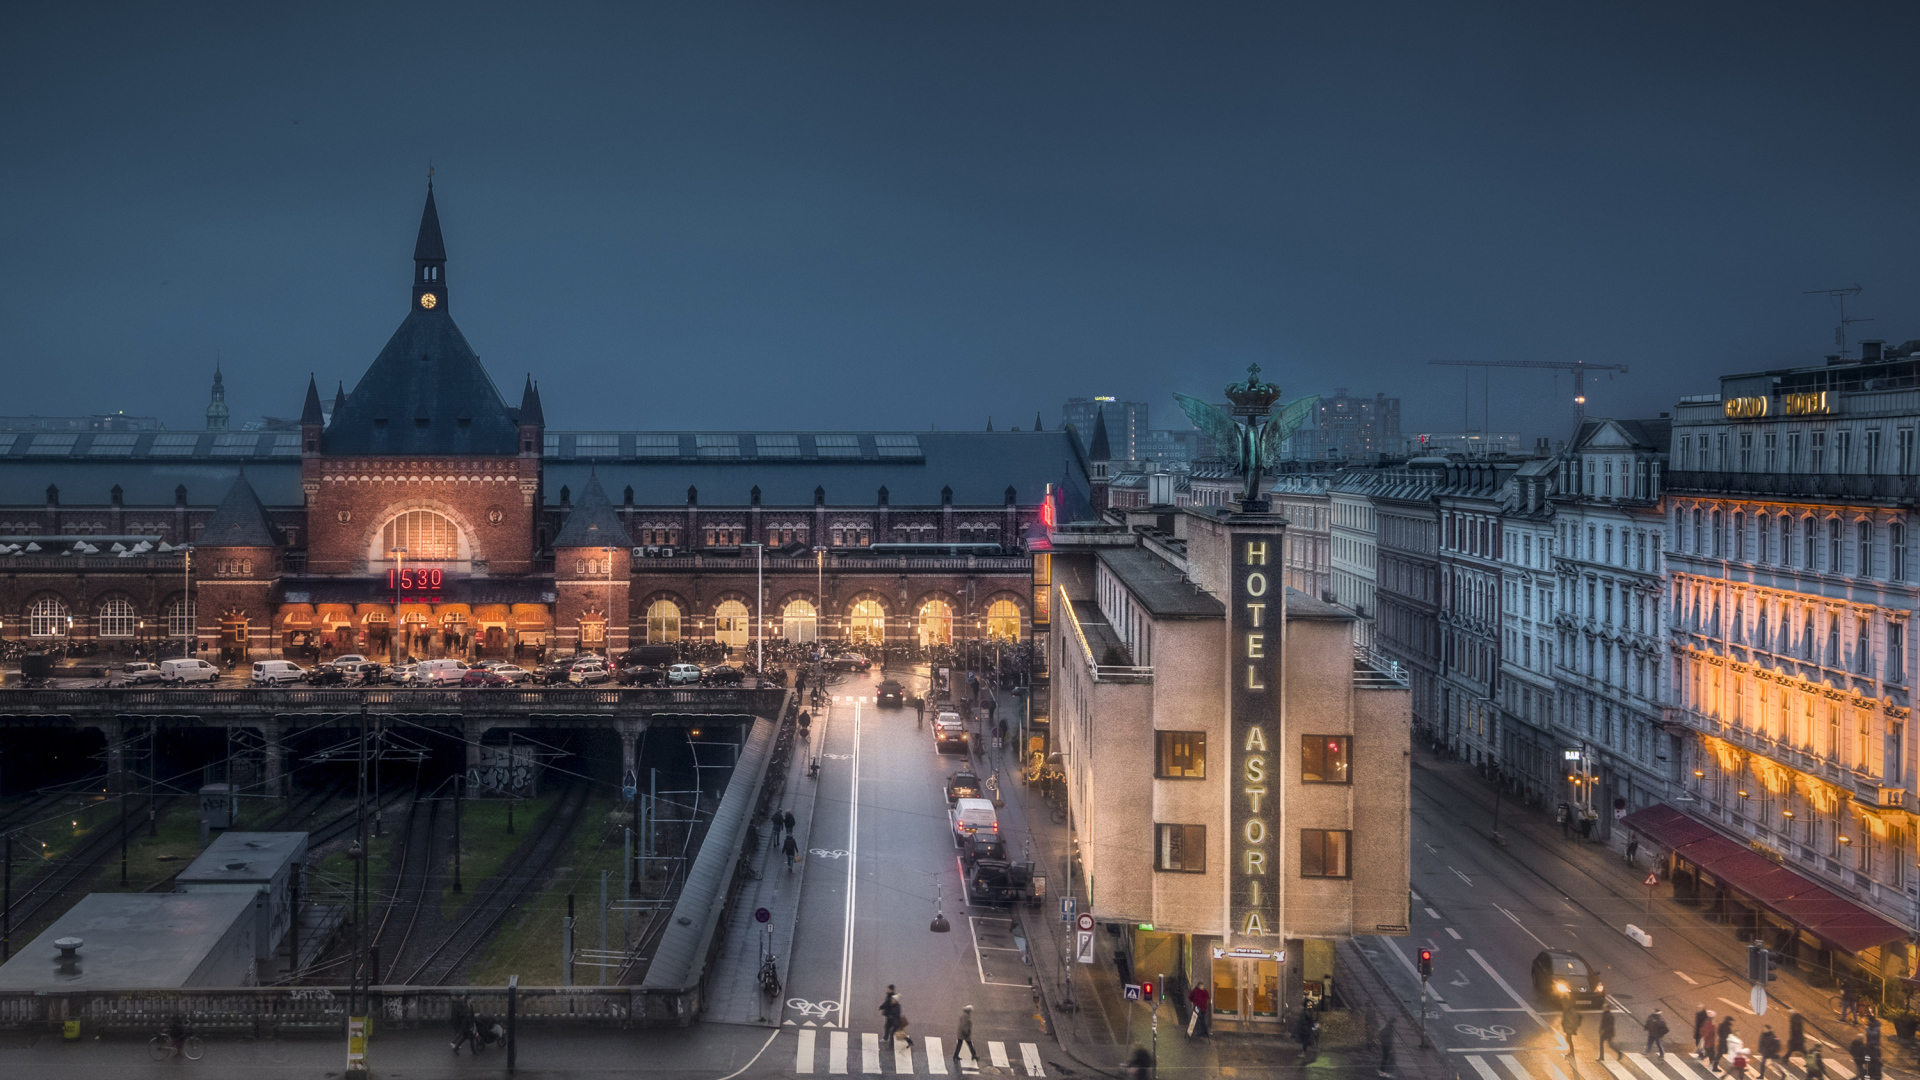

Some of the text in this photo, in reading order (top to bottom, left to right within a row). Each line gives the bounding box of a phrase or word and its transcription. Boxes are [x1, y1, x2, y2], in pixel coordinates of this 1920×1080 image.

[1725, 391, 1830, 417] GRAND HOTEL
[1246, 541, 1267, 690] HOTEL
[1565, 751, 1580, 760] BAR
[1245, 726, 1267, 937] ASTORIA
